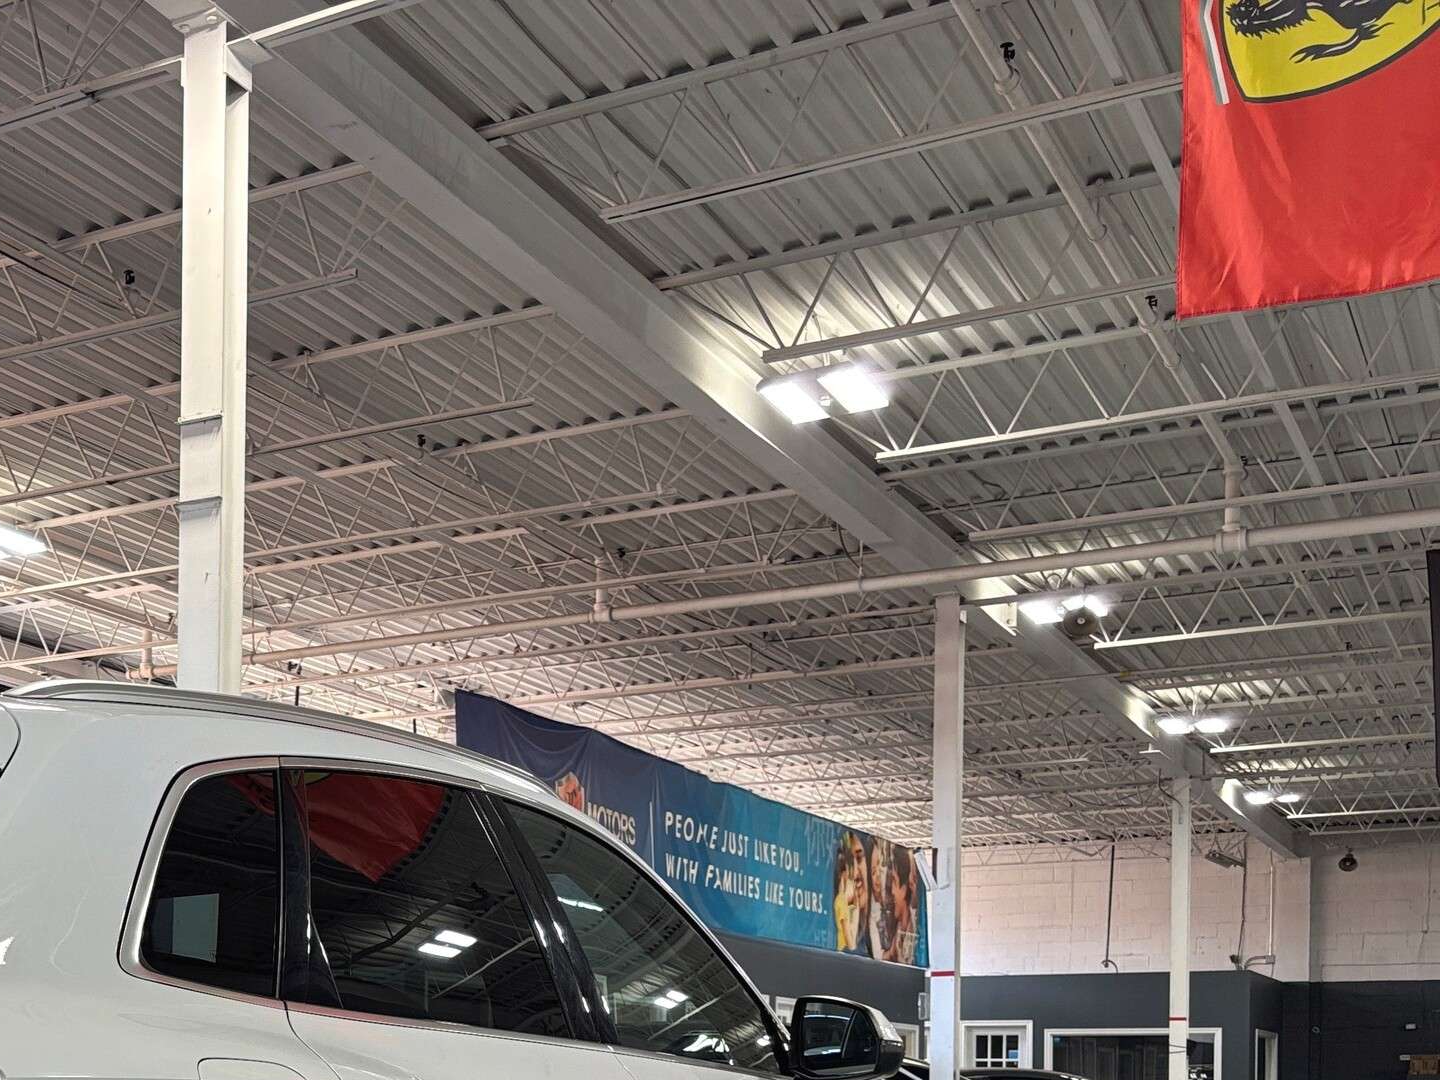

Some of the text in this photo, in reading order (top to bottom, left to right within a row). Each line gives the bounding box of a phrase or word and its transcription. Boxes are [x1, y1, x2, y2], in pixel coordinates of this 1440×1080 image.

[721, 829, 749, 858] JUST
[754, 838, 777, 865] LIKE
[665, 852, 699, 885] WITH
[704, 864, 760, 900] FAMILIES
[765, 881, 784, 906] LIKE
